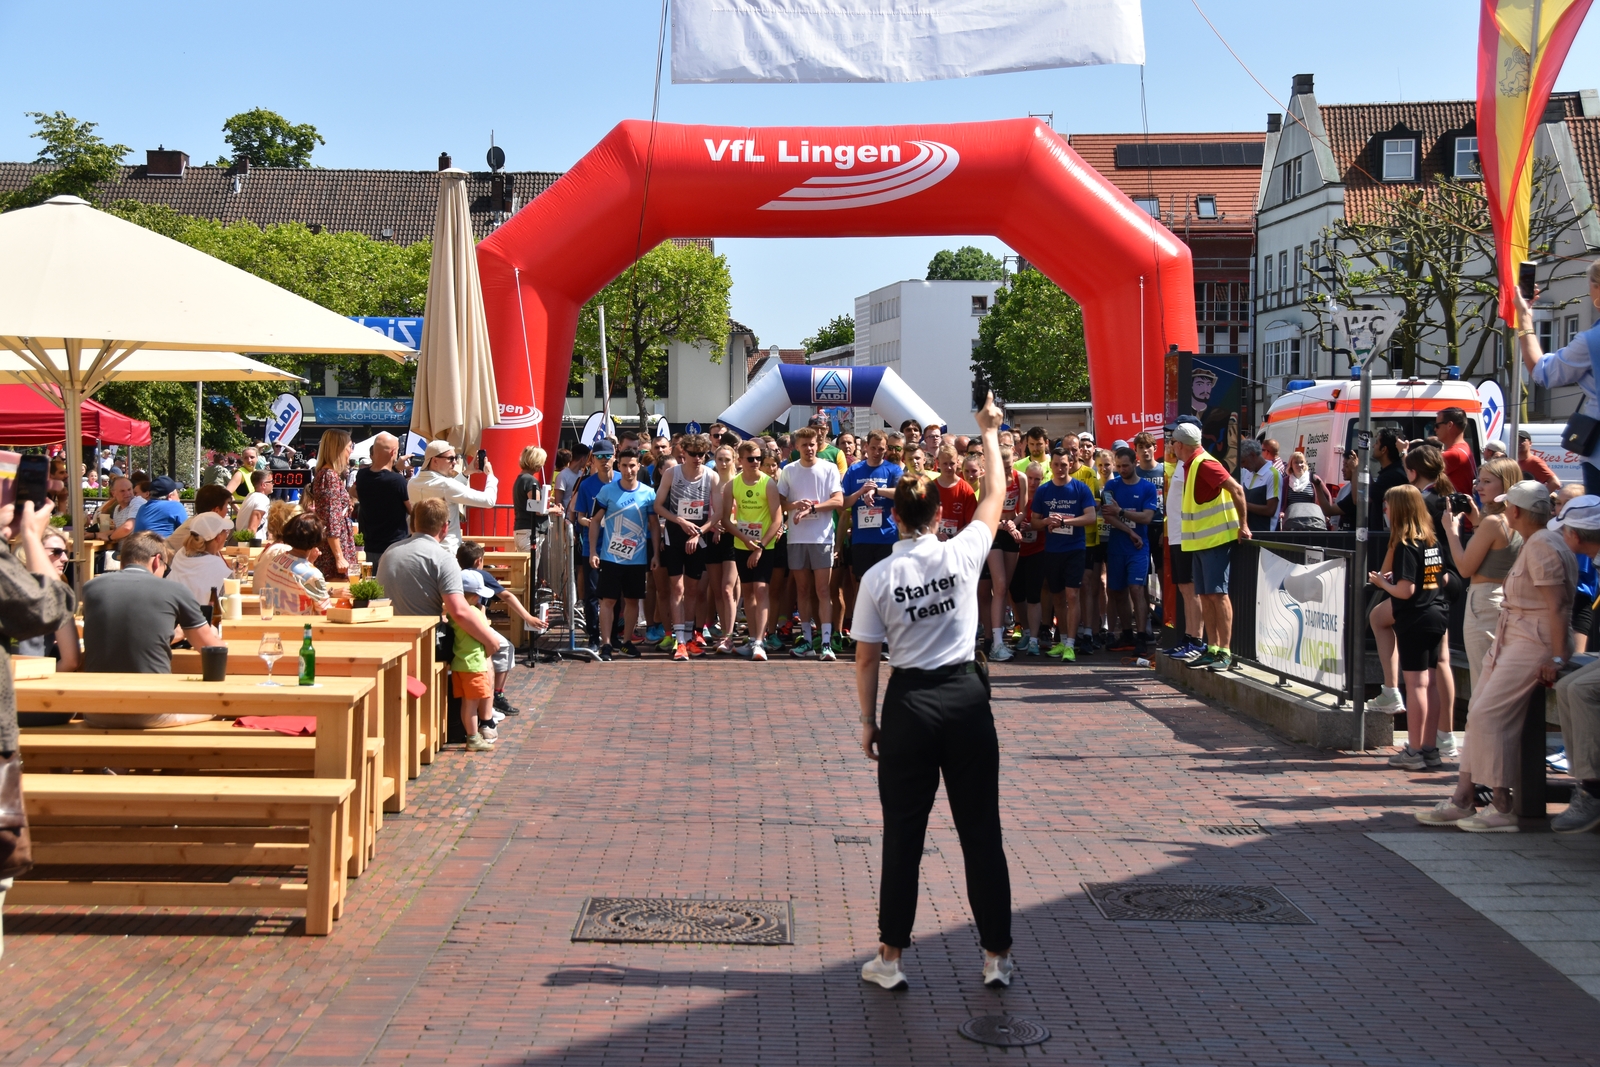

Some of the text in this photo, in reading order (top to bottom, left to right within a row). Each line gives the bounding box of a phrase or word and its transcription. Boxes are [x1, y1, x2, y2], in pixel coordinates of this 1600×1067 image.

[703, 138, 901, 170] VfL Lingen
[1343, 315, 1385, 335] WC
[336, 400, 392, 413] ERDINGER
[268, 402, 297, 443] ALDI
[337, 413, 406, 421] ALKOHOLFREI
[1106, 413, 1128, 425] VfL
[1308, 431, 1329, 444] Deutsches
[1306, 446, 1318, 457] Rotes
[271, 473, 303, 485] 0:00
[620, 497, 636, 507] TEAM
[683, 507, 699, 515] 104
[864, 515, 875, 524] 67
[609, 541, 634, 555] 2227
[893, 574, 956, 603] Starter
[905, 596, 956, 622] Team
[1302, 637, 1338, 675] LINGEN
